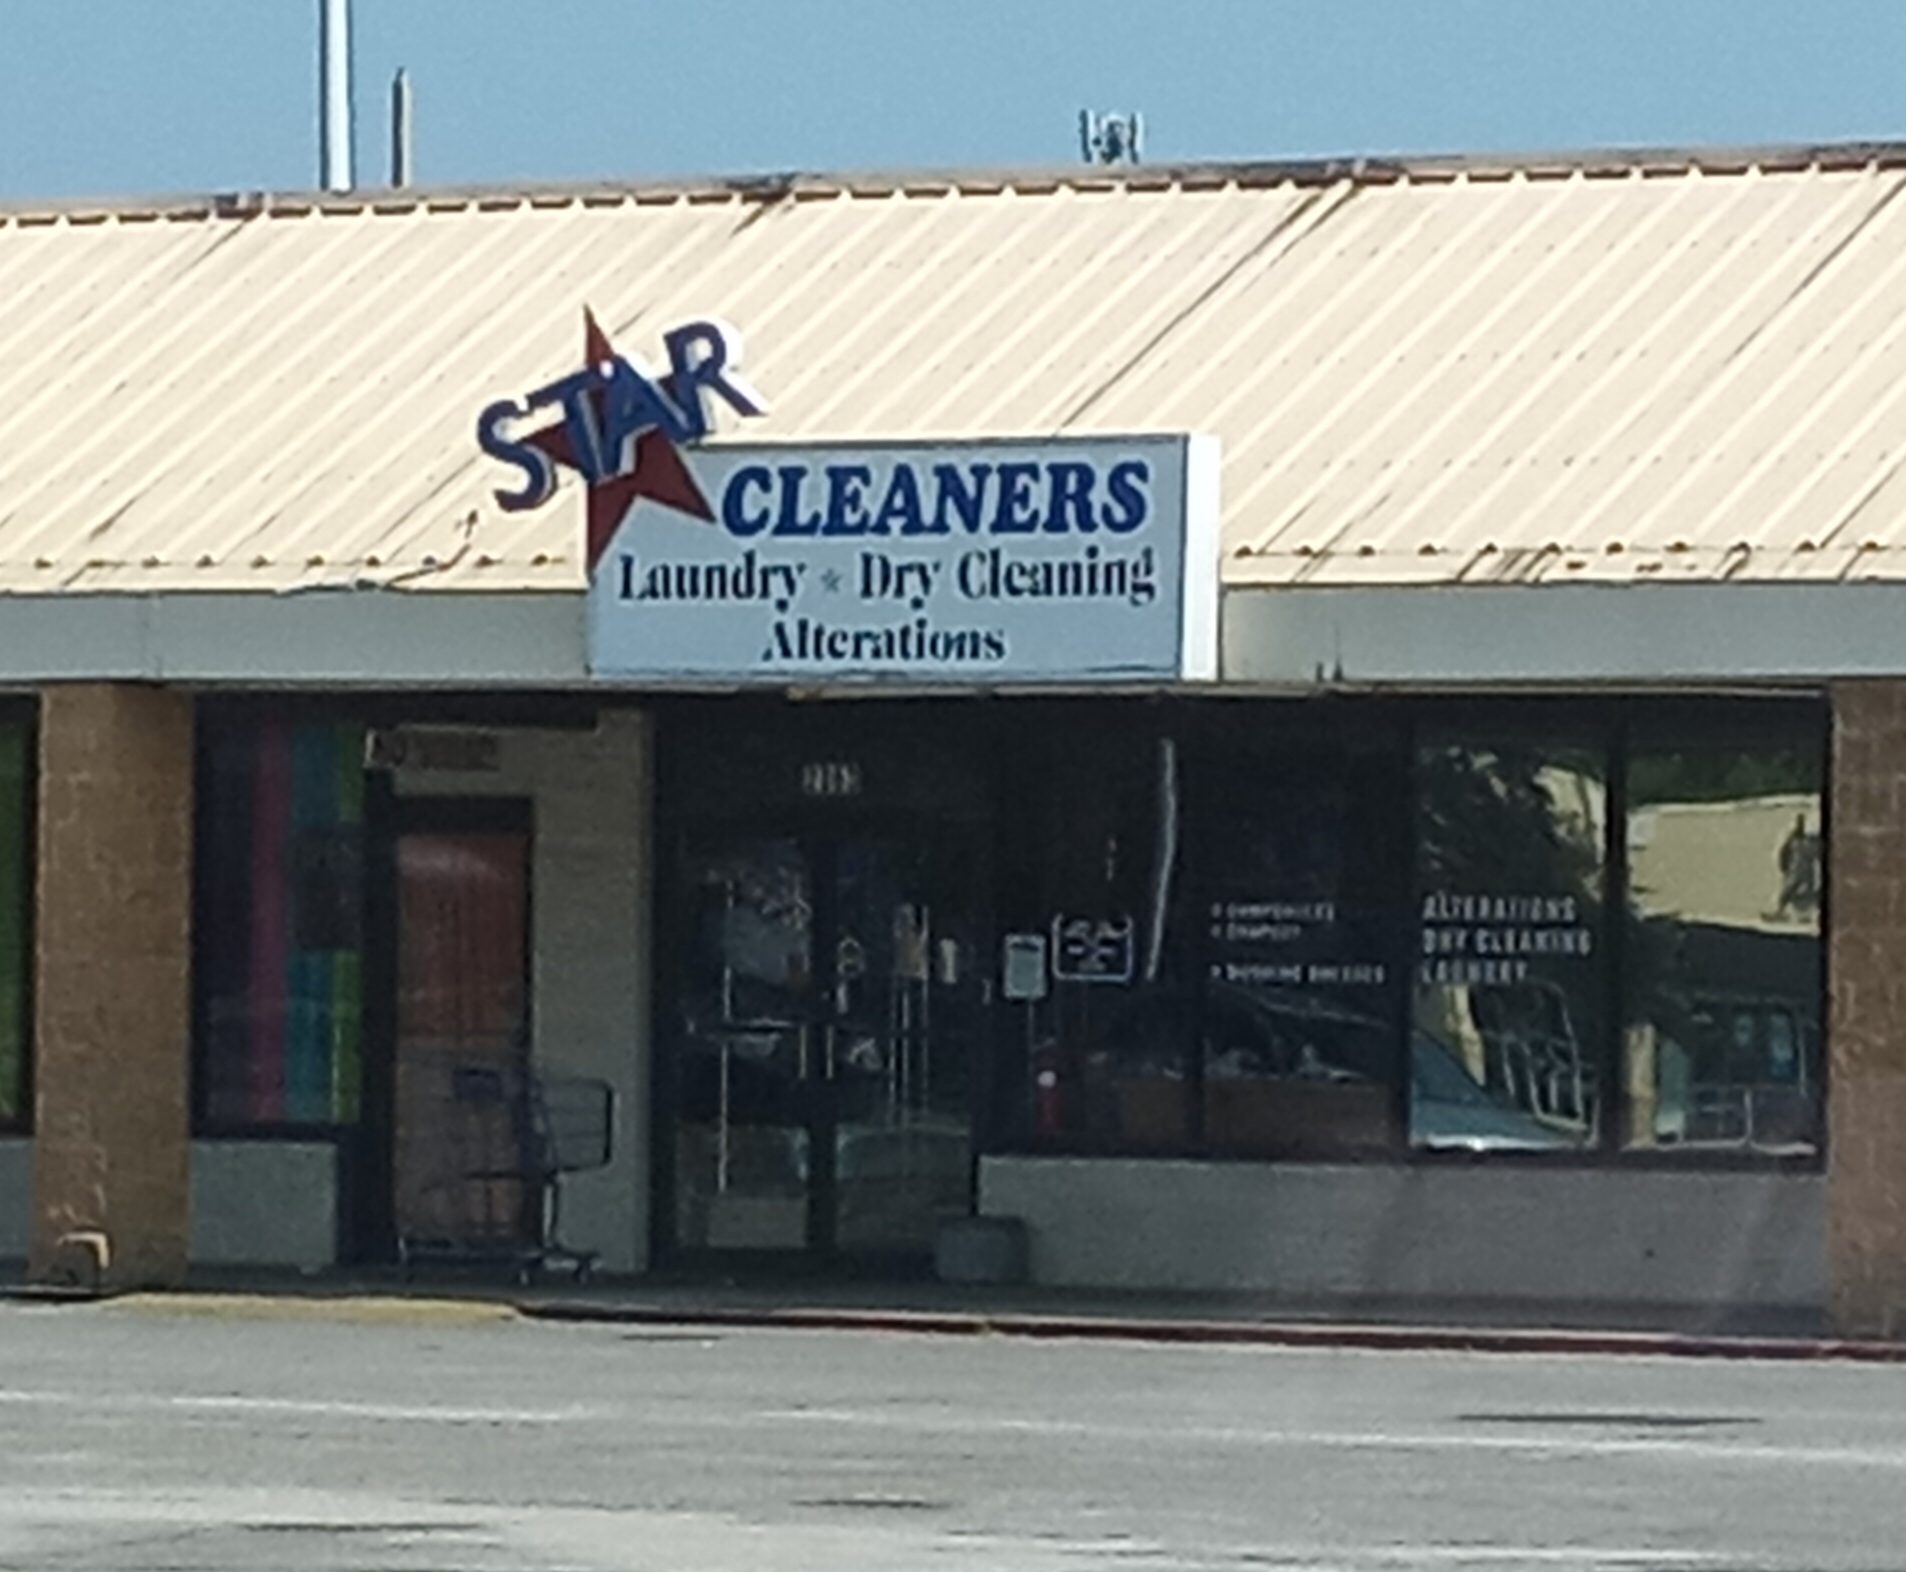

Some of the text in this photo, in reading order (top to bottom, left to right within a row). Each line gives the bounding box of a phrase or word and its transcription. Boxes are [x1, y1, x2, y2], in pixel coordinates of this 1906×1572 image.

[477, 321, 764, 512] STAR
[721, 459, 1149, 538] CLEANERS
[619, 545, 1156, 614] Laundry Dry Cleaning
[761, 618, 1006, 662] Alterations
